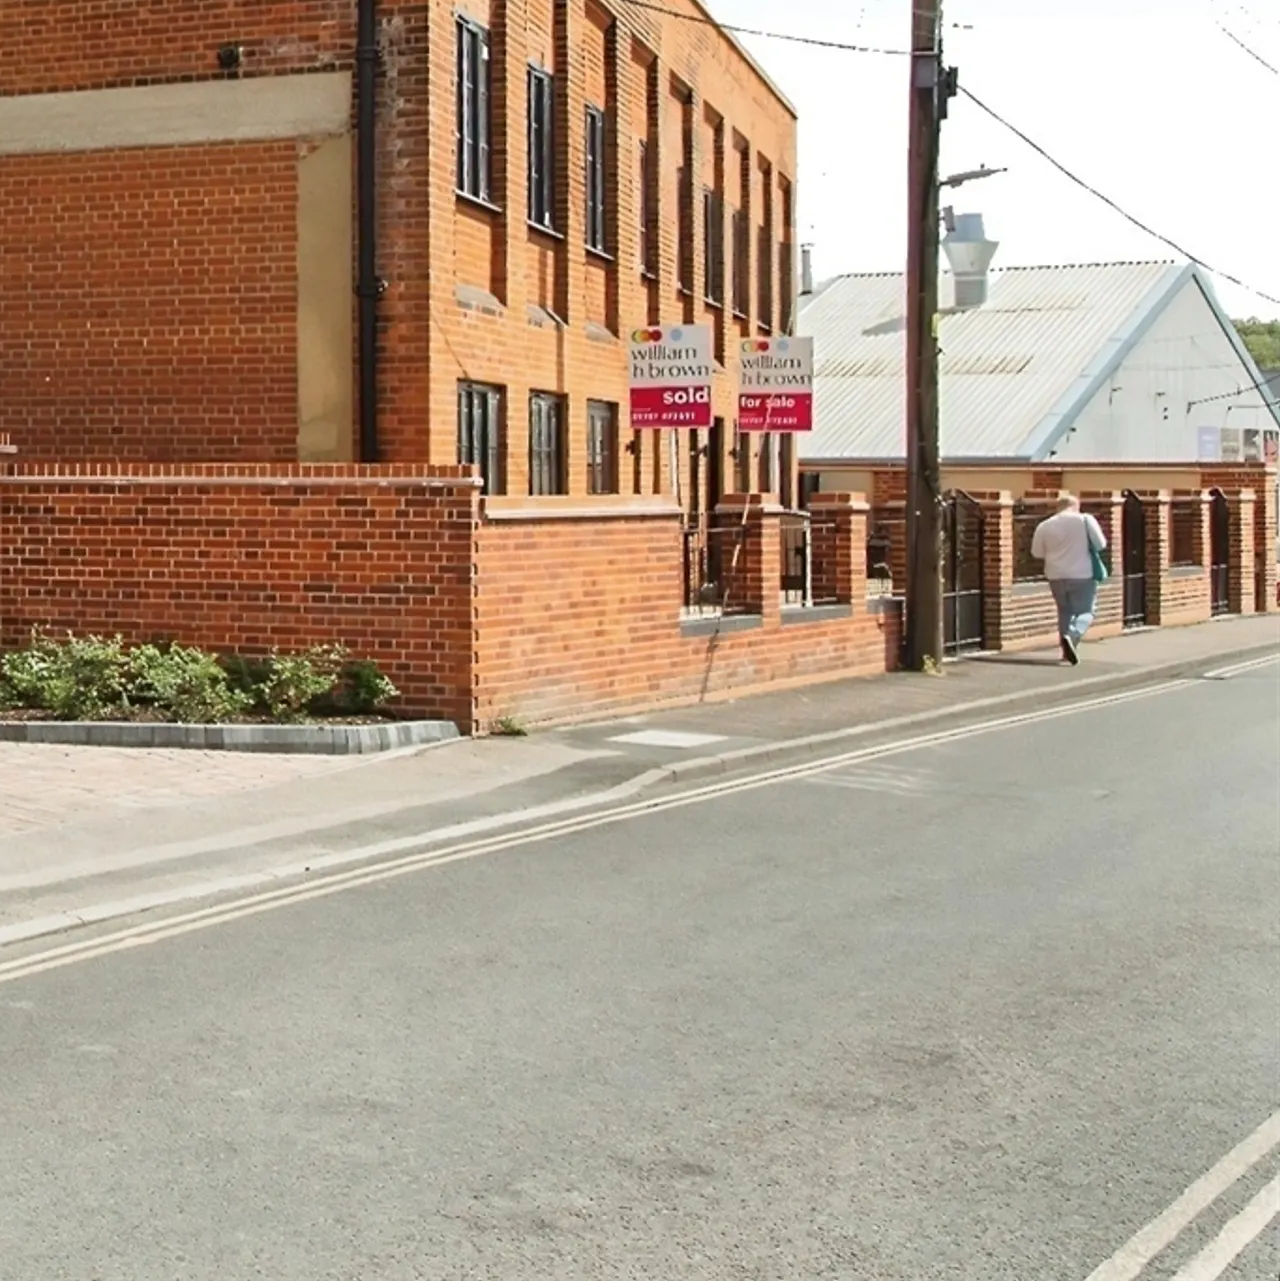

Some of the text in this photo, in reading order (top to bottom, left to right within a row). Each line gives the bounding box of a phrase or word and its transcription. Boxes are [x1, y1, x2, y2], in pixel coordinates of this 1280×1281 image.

[631, 345, 697, 360] william
[740, 355, 801, 369] william
[633, 363, 709, 378] h brown
[742, 372, 812, 385] h brown
[662, 386, 709, 405] sold
[741, 396, 796, 408] for sale
